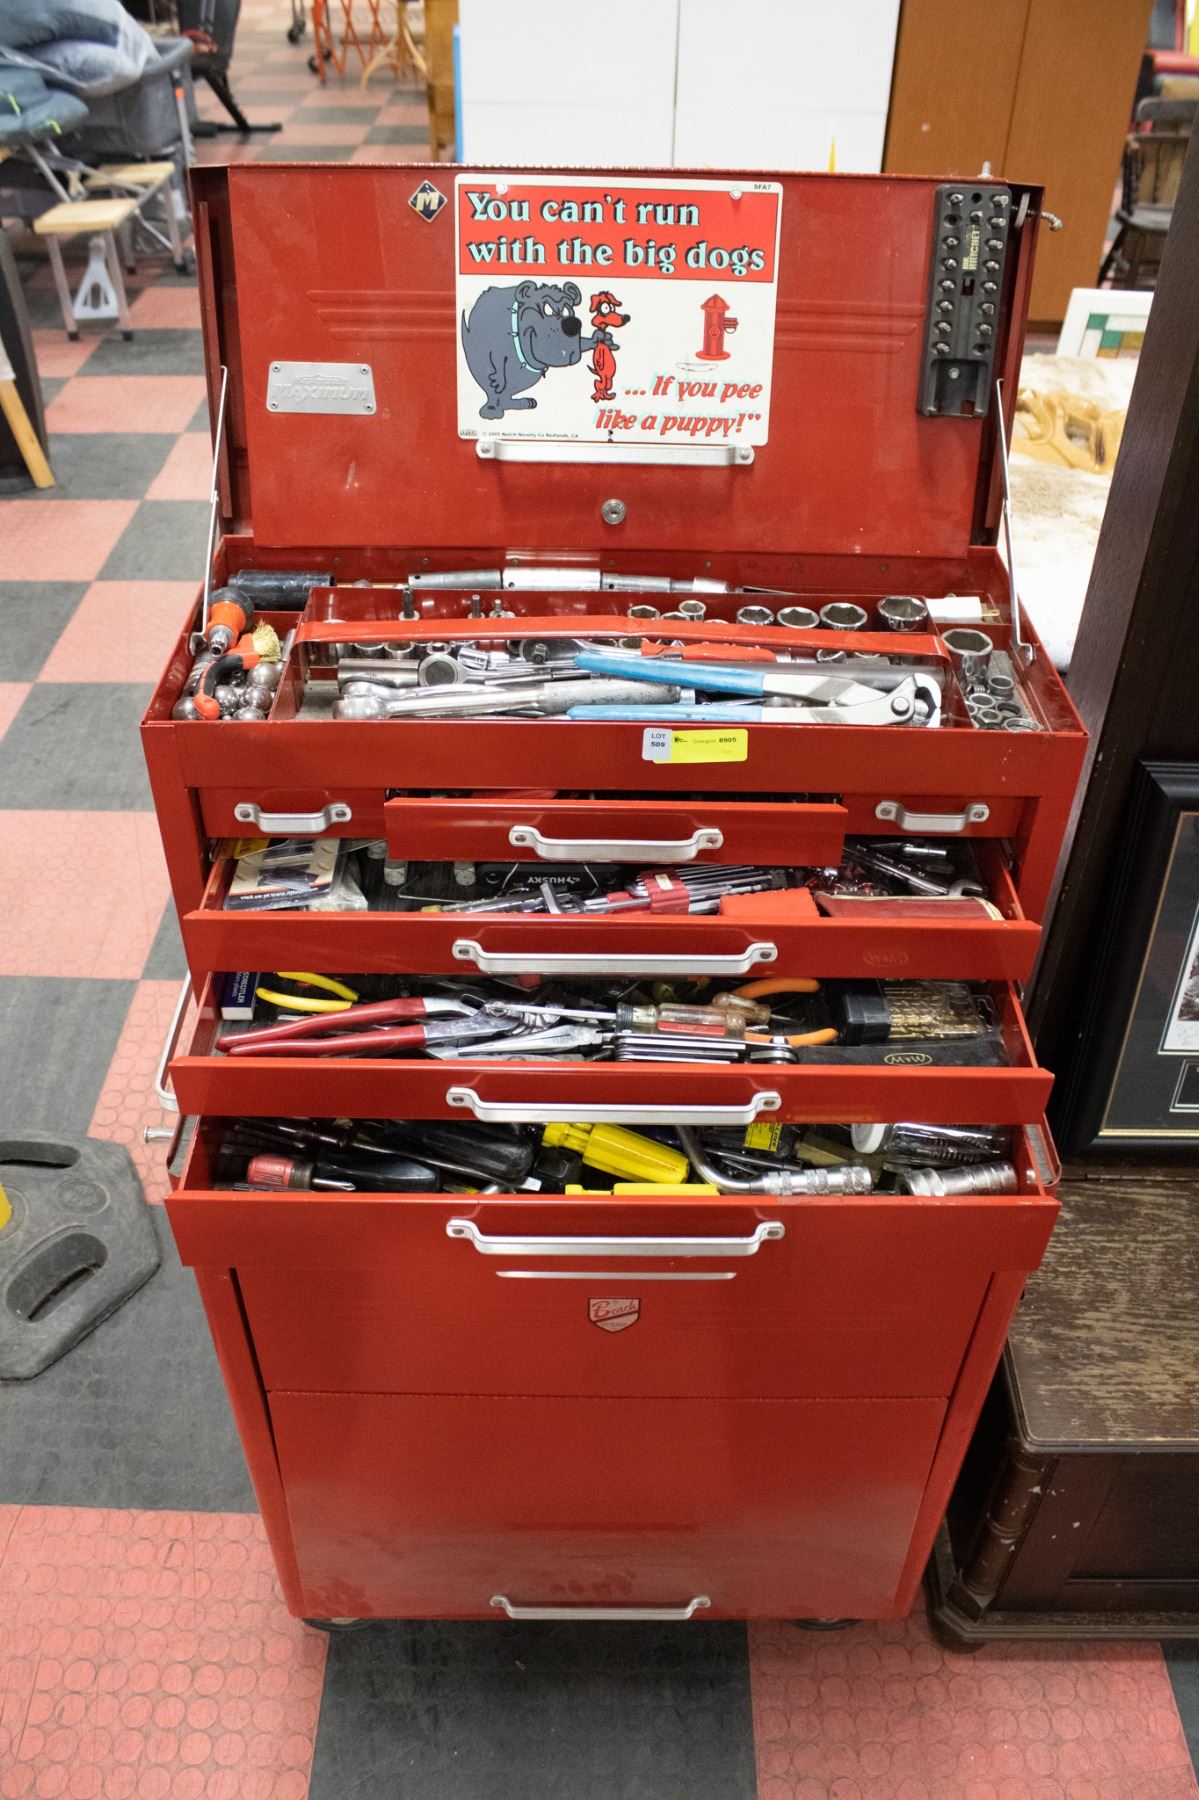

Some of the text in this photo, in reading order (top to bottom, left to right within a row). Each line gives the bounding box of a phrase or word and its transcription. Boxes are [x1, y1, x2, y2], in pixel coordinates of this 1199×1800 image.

[415, 191, 440, 211] M
[465, 191, 700, 227] You can't run
[465, 235, 766, 277] with the big dogs
[652, 374, 676, 396] If
[677, 381, 718, 402] you
[719, 382, 763, 403] pee
[595, 408, 638, 430] like
[640, 414, 658, 431] a
[527, 876, 566, 884] HUSKY
